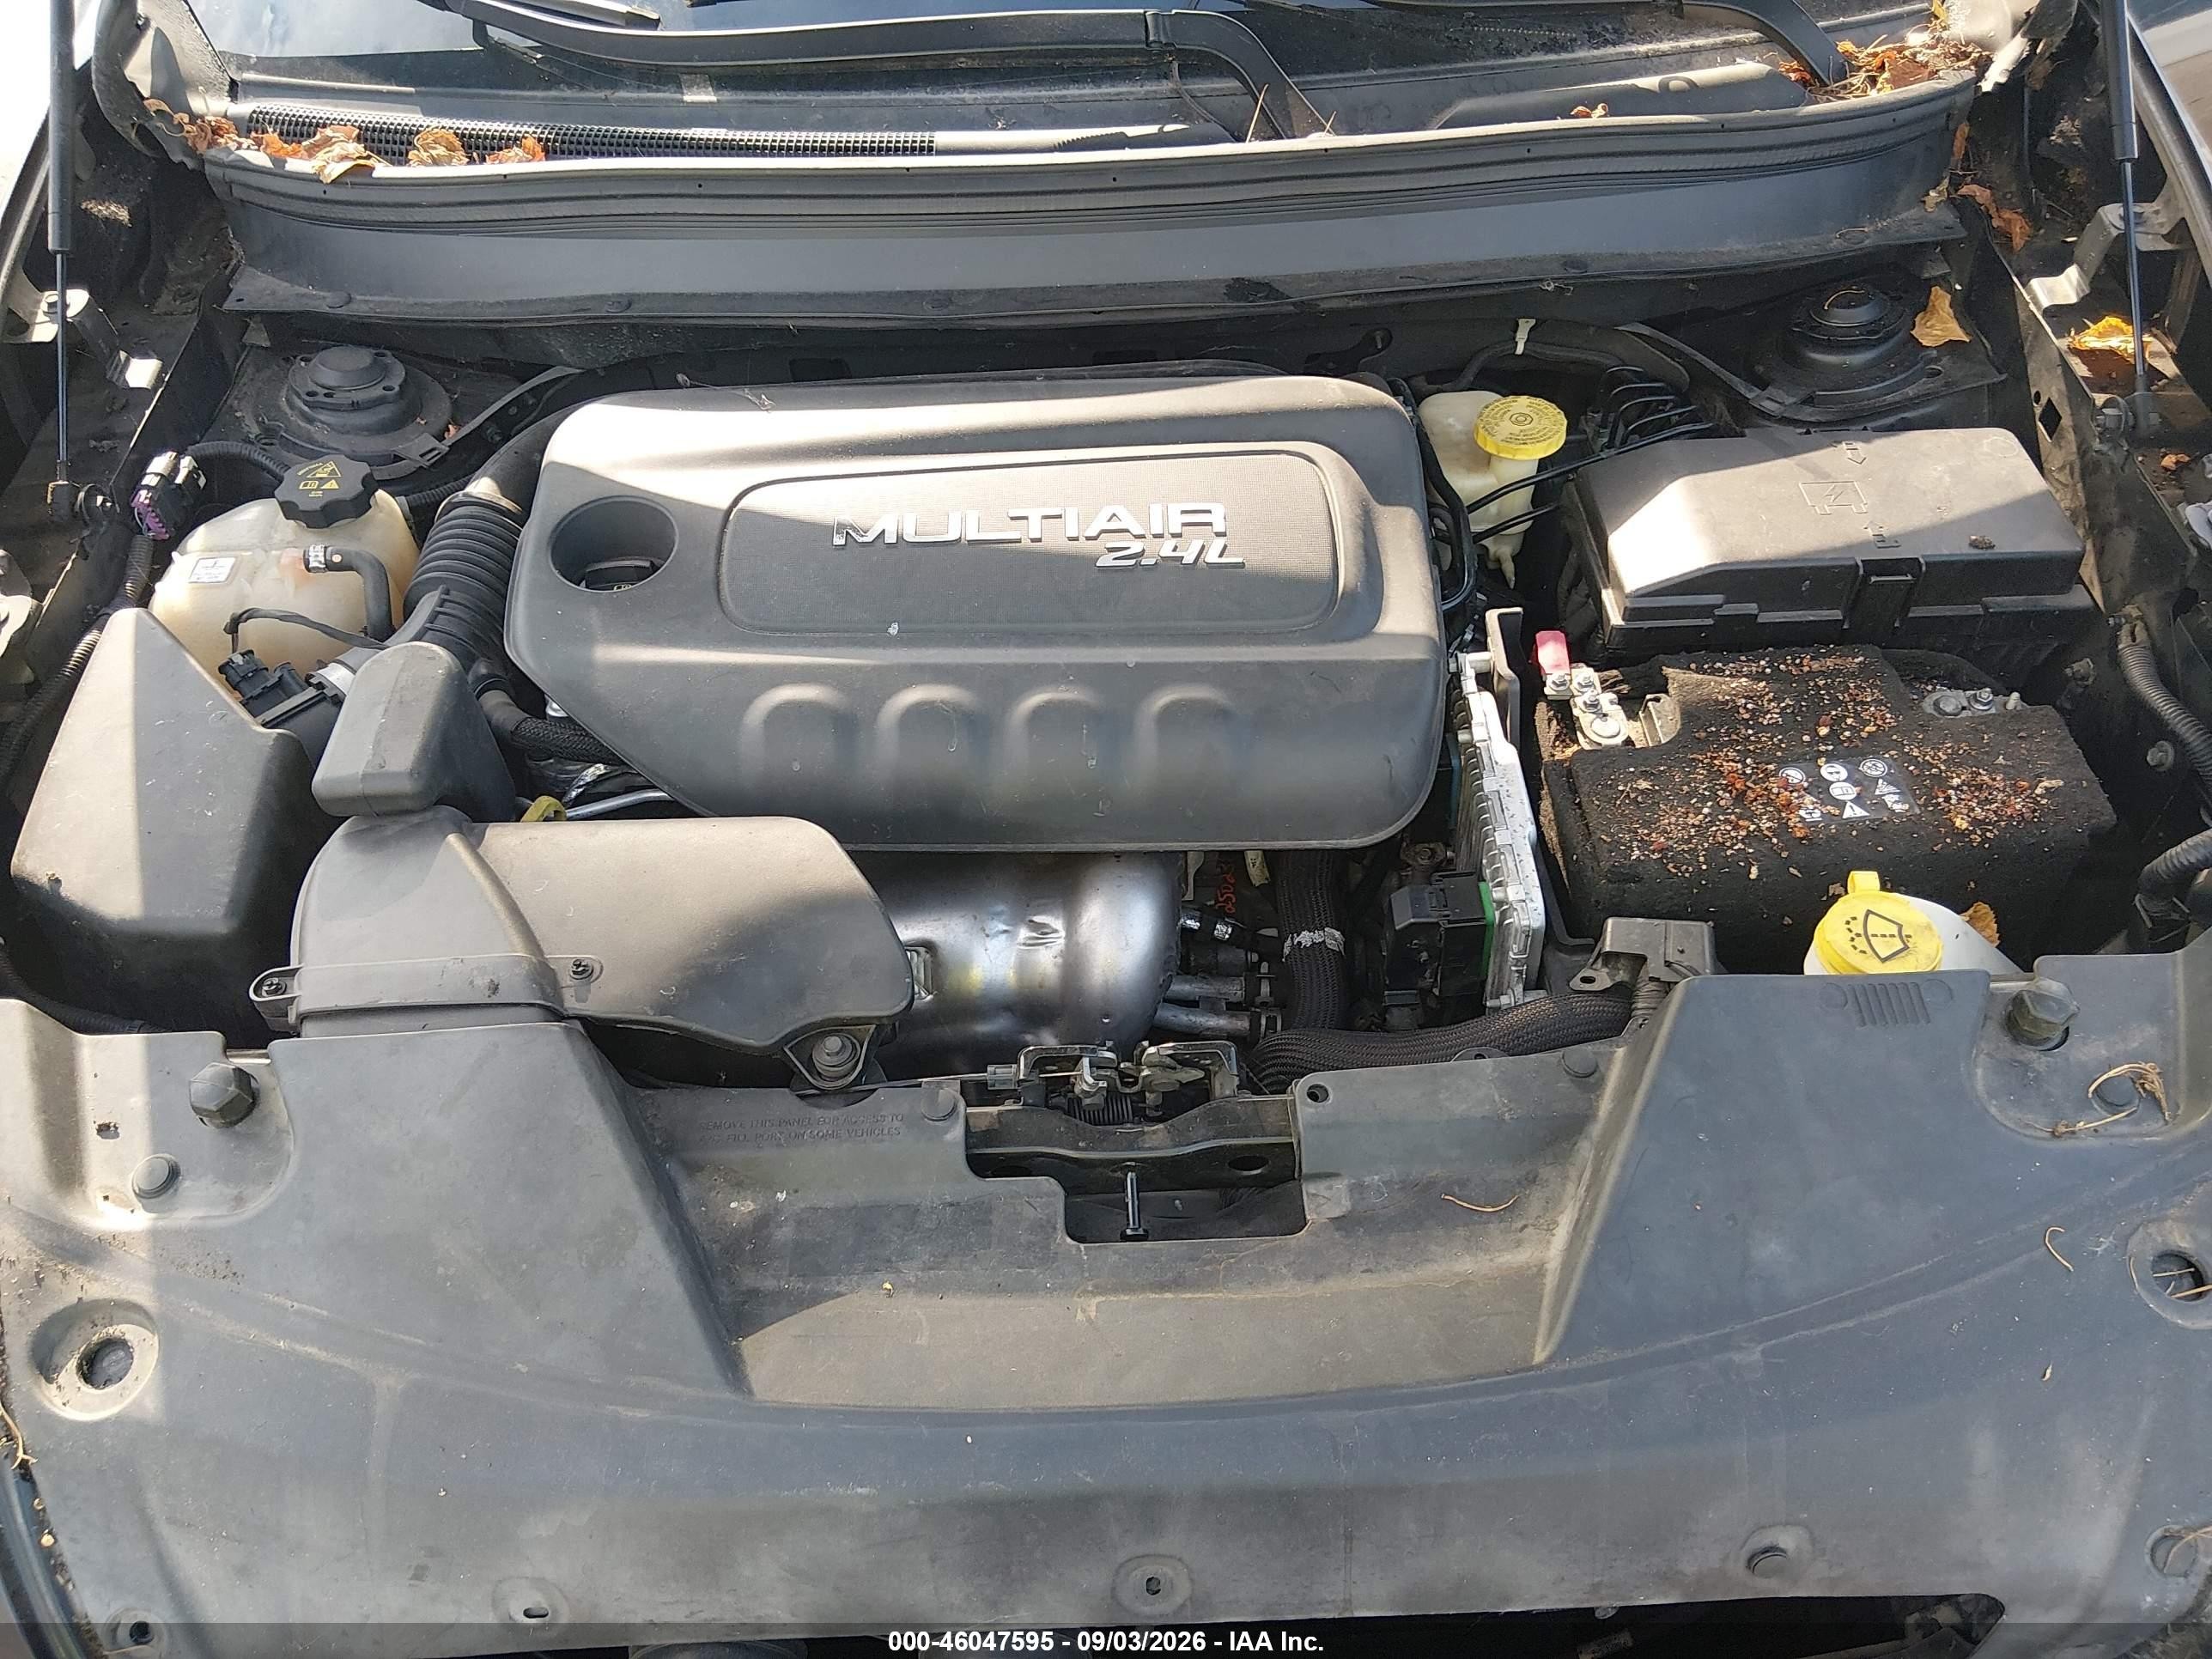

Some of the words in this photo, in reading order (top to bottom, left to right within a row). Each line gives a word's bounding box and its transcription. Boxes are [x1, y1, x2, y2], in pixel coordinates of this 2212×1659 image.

[832, 502, 1226, 546] MULTIAIR
[1095, 539, 1246, 568] 2.4L
[750, 1119, 775, 1128] THIS
[778, 1117, 812, 1127] PANEL
[890, 1113, 904, 1122] TO
[788, 1130, 807, 1141] ON
[809, 1128, 842, 1140] SOME
[847, 1126, 902, 1138] VEHICLES
